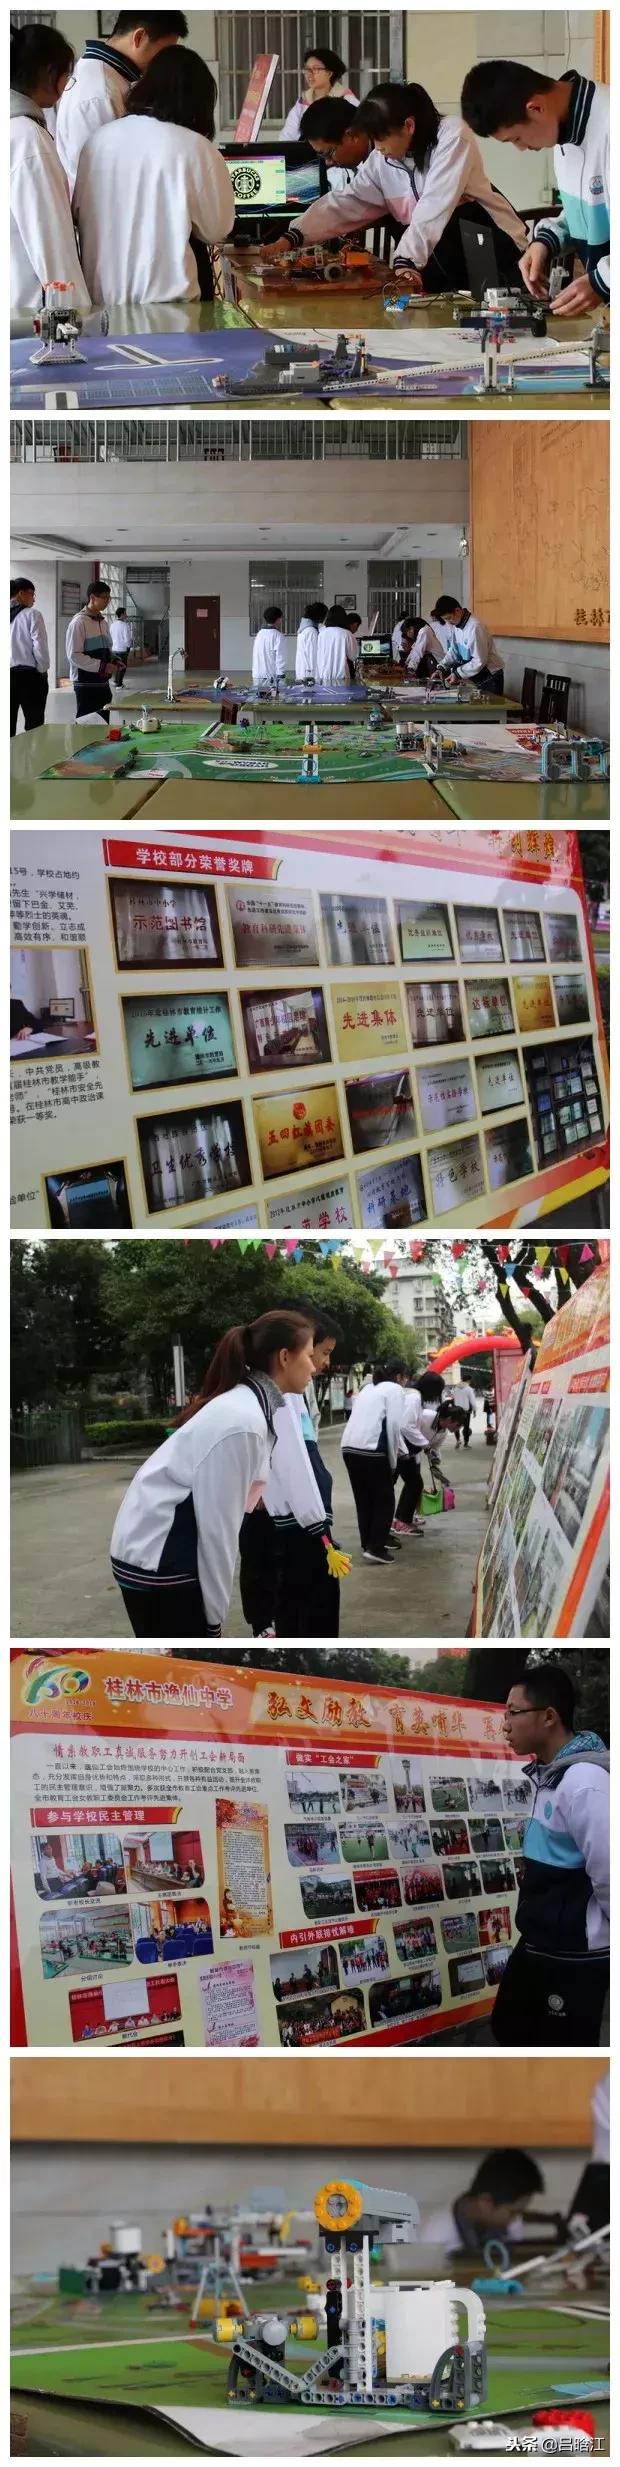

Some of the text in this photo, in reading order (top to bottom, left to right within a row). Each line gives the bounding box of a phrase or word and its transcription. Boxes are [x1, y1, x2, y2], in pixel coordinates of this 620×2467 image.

[231, 167, 260, 182] STARBUCKS
[233, 188, 257, 200] COFFEE
[136, 847, 254, 875] 学校部分荣誉奖牌
[133, 915, 208, 932] 示范图书馆
[342, 1008, 397, 1030] 先进集体
[144, 1025, 217, 1049] 先进单位
[104, 1676, 234, 1710] 桂林市逸仙中学
[47, 1810, 146, 1823] 参与学校民主管理
